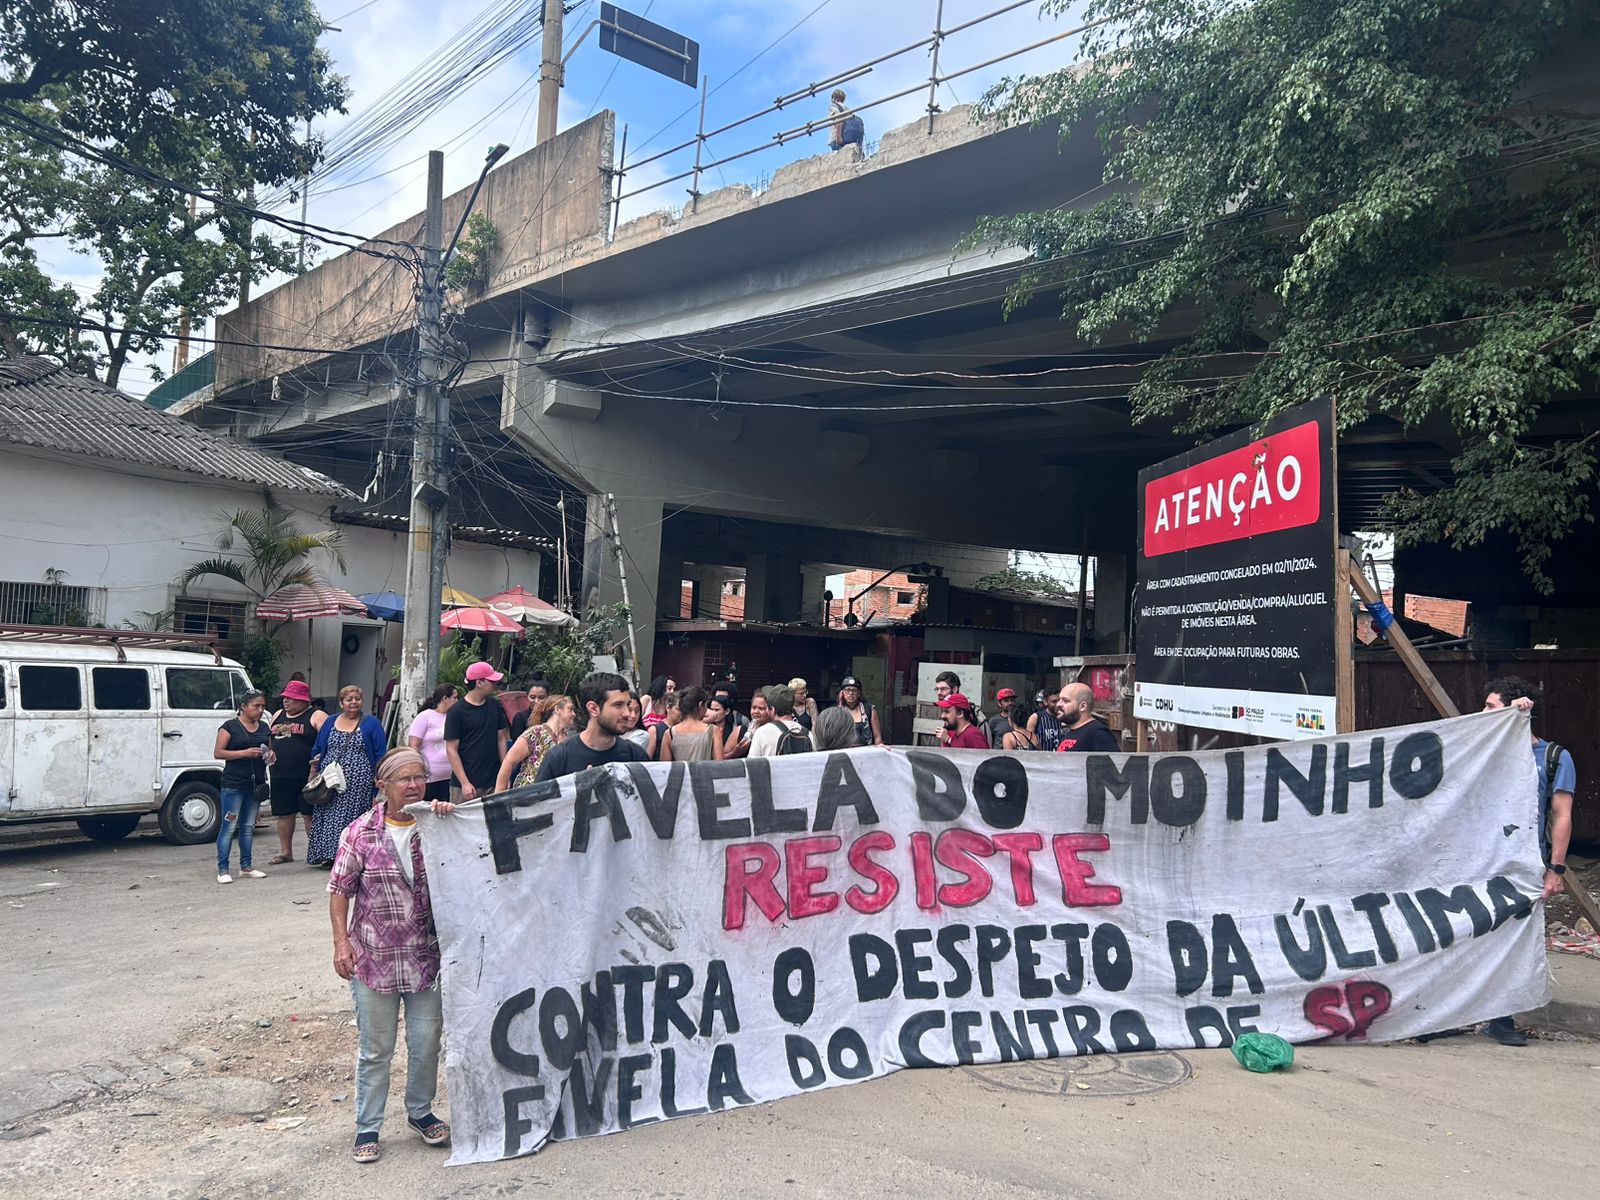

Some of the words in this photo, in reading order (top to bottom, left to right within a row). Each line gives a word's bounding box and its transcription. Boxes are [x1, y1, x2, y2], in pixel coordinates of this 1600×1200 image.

[1154, 452, 1302, 534] ATENÇÃO
[1146, 579, 1159, 591] ÁREA
[1171, 570, 1219, 588] CADASTRAMENTO
[1220, 564, 1260, 581] CONGELADO
[1261, 563, 1273, 576] EM
[1274, 556, 1318, 574] 02/11/2024.
[1141, 605, 1152, 617] NÃO
[1152, 604, 1156, 616] É
[1156, 605, 1180, 616] PERMITIDA
[1180, 604, 1186, 615] A
[1181, 618, 1189, 629] DE
[1190, 615, 1214, 628] IMÓVEIS
[1215, 616, 1236, 627] NESTA
[1237, 613, 1257, 626] ÁREA.
[1153, 645, 1166, 657] ÁREA
[1219, 647, 1236, 658] PARA
[1237, 647, 1270, 658] FUTURAS
[1271, 647, 1300, 659] OBRAS.
[1155, 698, 1174, 712] CDHU
[483, 752, 880, 875] FAVELA
[906, 750, 1029, 829] DO
[1086, 730, 1444, 827] MOINHO
[721, 827, 1122, 931] RESISTE
[491, 959, 741, 1077] CONTRA
[773, 946, 816, 1027] O
[848, 922, 1134, 1002] DESPEJO
[1166, 913, 1266, 997] DA
[1273, 876, 1533, 982] ÚLTIMA
[785, 1026, 874, 1089] DO
[899, 1005, 1156, 1068] CENTRO
[1303, 979, 1393, 1041] SP
